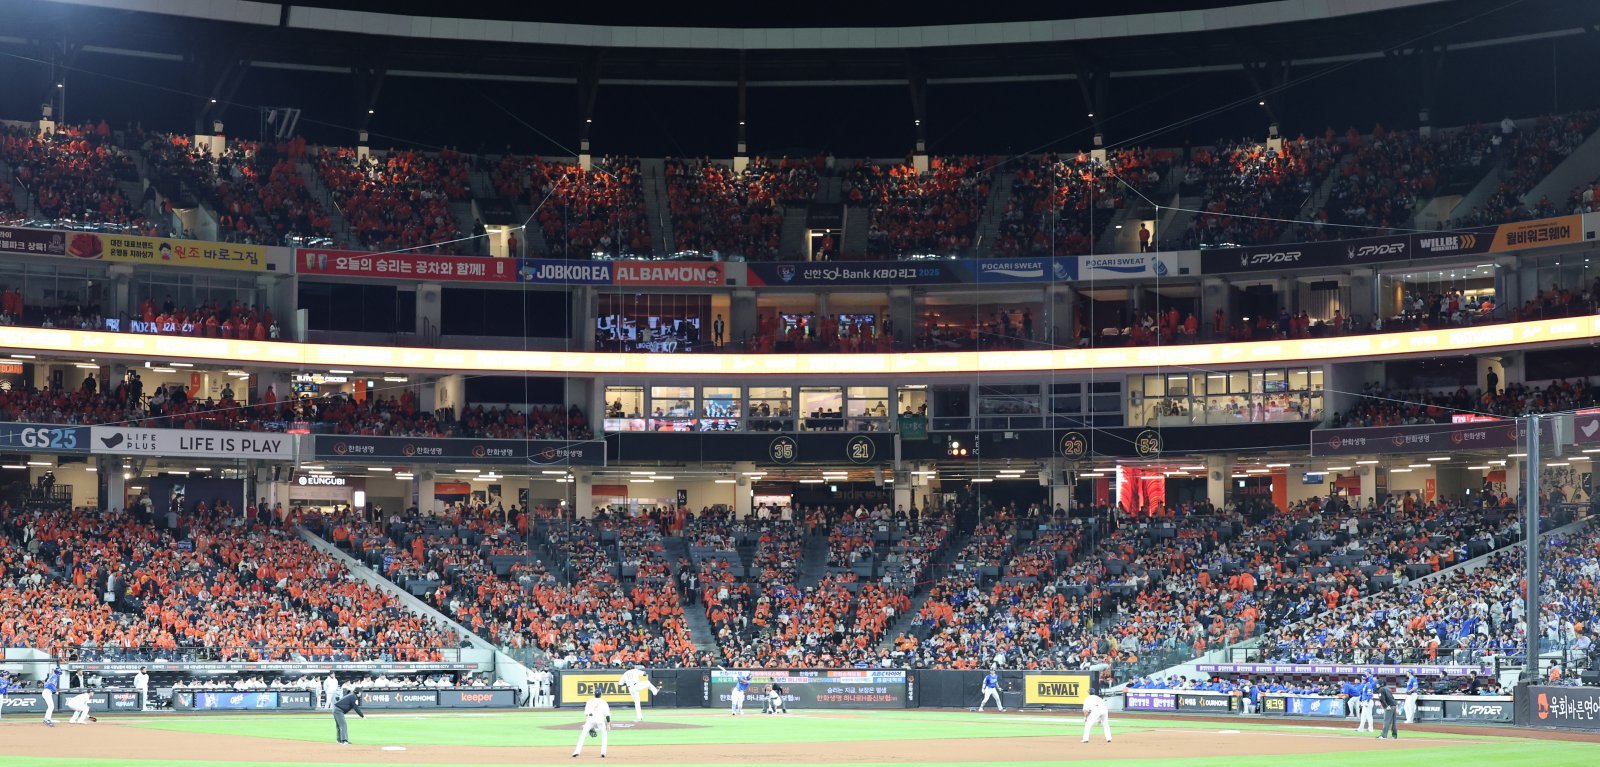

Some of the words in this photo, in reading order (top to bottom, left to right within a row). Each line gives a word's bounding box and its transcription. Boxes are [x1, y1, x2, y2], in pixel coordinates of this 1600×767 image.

[1506, 225, 1570, 246] 윌비워크웨어
[110, 239, 123, 247] 대전
[123, 240, 153, 249] 대표브랜드
[1420, 236, 1459, 249] WILLBE
[110, 248, 128, 257] 은행동
[129, 249, 154, 259] 지하상가
[174, 245, 201, 260] 원조
[203, 248, 258, 265] 바로그집
[1356, 243, 1405, 256] SPYDER
[1085, 258, 1116, 267] POCARI
[1116, 257, 1146, 265] SWEAT
[1250, 251, 1302, 264] SPYDER
[335, 257, 372, 272] 오늘의
[375, 259, 412, 273] 승리는
[416, 260, 453, 275] 공차와
[456, 262, 486, 276] 함께!
[981, 262, 1013, 270] POCARI
[1014, 262, 1043, 270] SWEAT
[536, 264, 610, 281] JOBKOREA
[803, 269, 822, 280] 신한
[842, 269, 871, 279] Bank
[872, 269, 898, 279] KBO
[898, 268, 917, 279] 리그
[918, 268, 941, 277] 2025
[20, 427, 77, 450] GS25
[127, 433, 156, 441] LIFE
[1463, 431, 1486, 441] 한화생명
[127, 443, 156, 451] PLUS
[179, 436, 214, 451] LIFE
[220, 438, 235, 452] IS
[241, 439, 281, 453] PLAY
[348, 445, 375, 454] 한화생명
[1064, 440, 1083, 455] 23
[1140, 438, 1159, 454] 52
[416, 447, 443, 455] 한화생명
[486, 448, 513, 457] 한화생명
[556, 449, 583, 458] 한화생명
[774, 444, 793, 459] 35
[852, 444, 869, 459] 21
[307, 477, 346, 486] EUNGUBI
[373, 694, 390, 703] 아워홈
[461, 692, 493, 703] keeper
[1468, 705, 1502, 715] SPYDER
[1549, 695, 1600, 720] 육회바른연어
